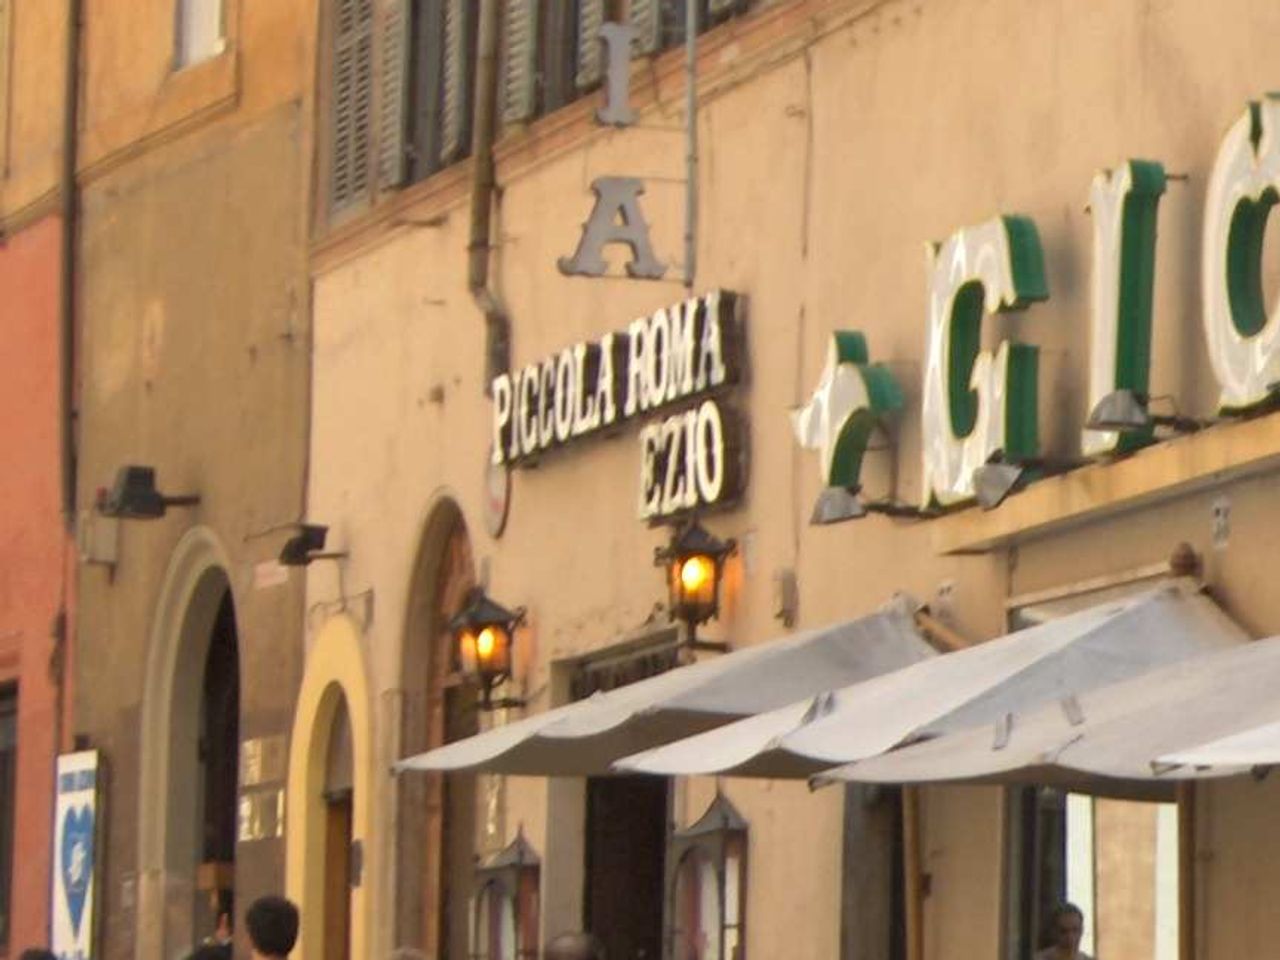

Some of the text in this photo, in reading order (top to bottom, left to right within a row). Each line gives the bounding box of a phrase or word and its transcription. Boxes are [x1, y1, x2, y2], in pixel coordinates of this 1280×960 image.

[491, 288, 726, 466] PICCOLA ROMA
[639, 400, 724, 520] EZIO
